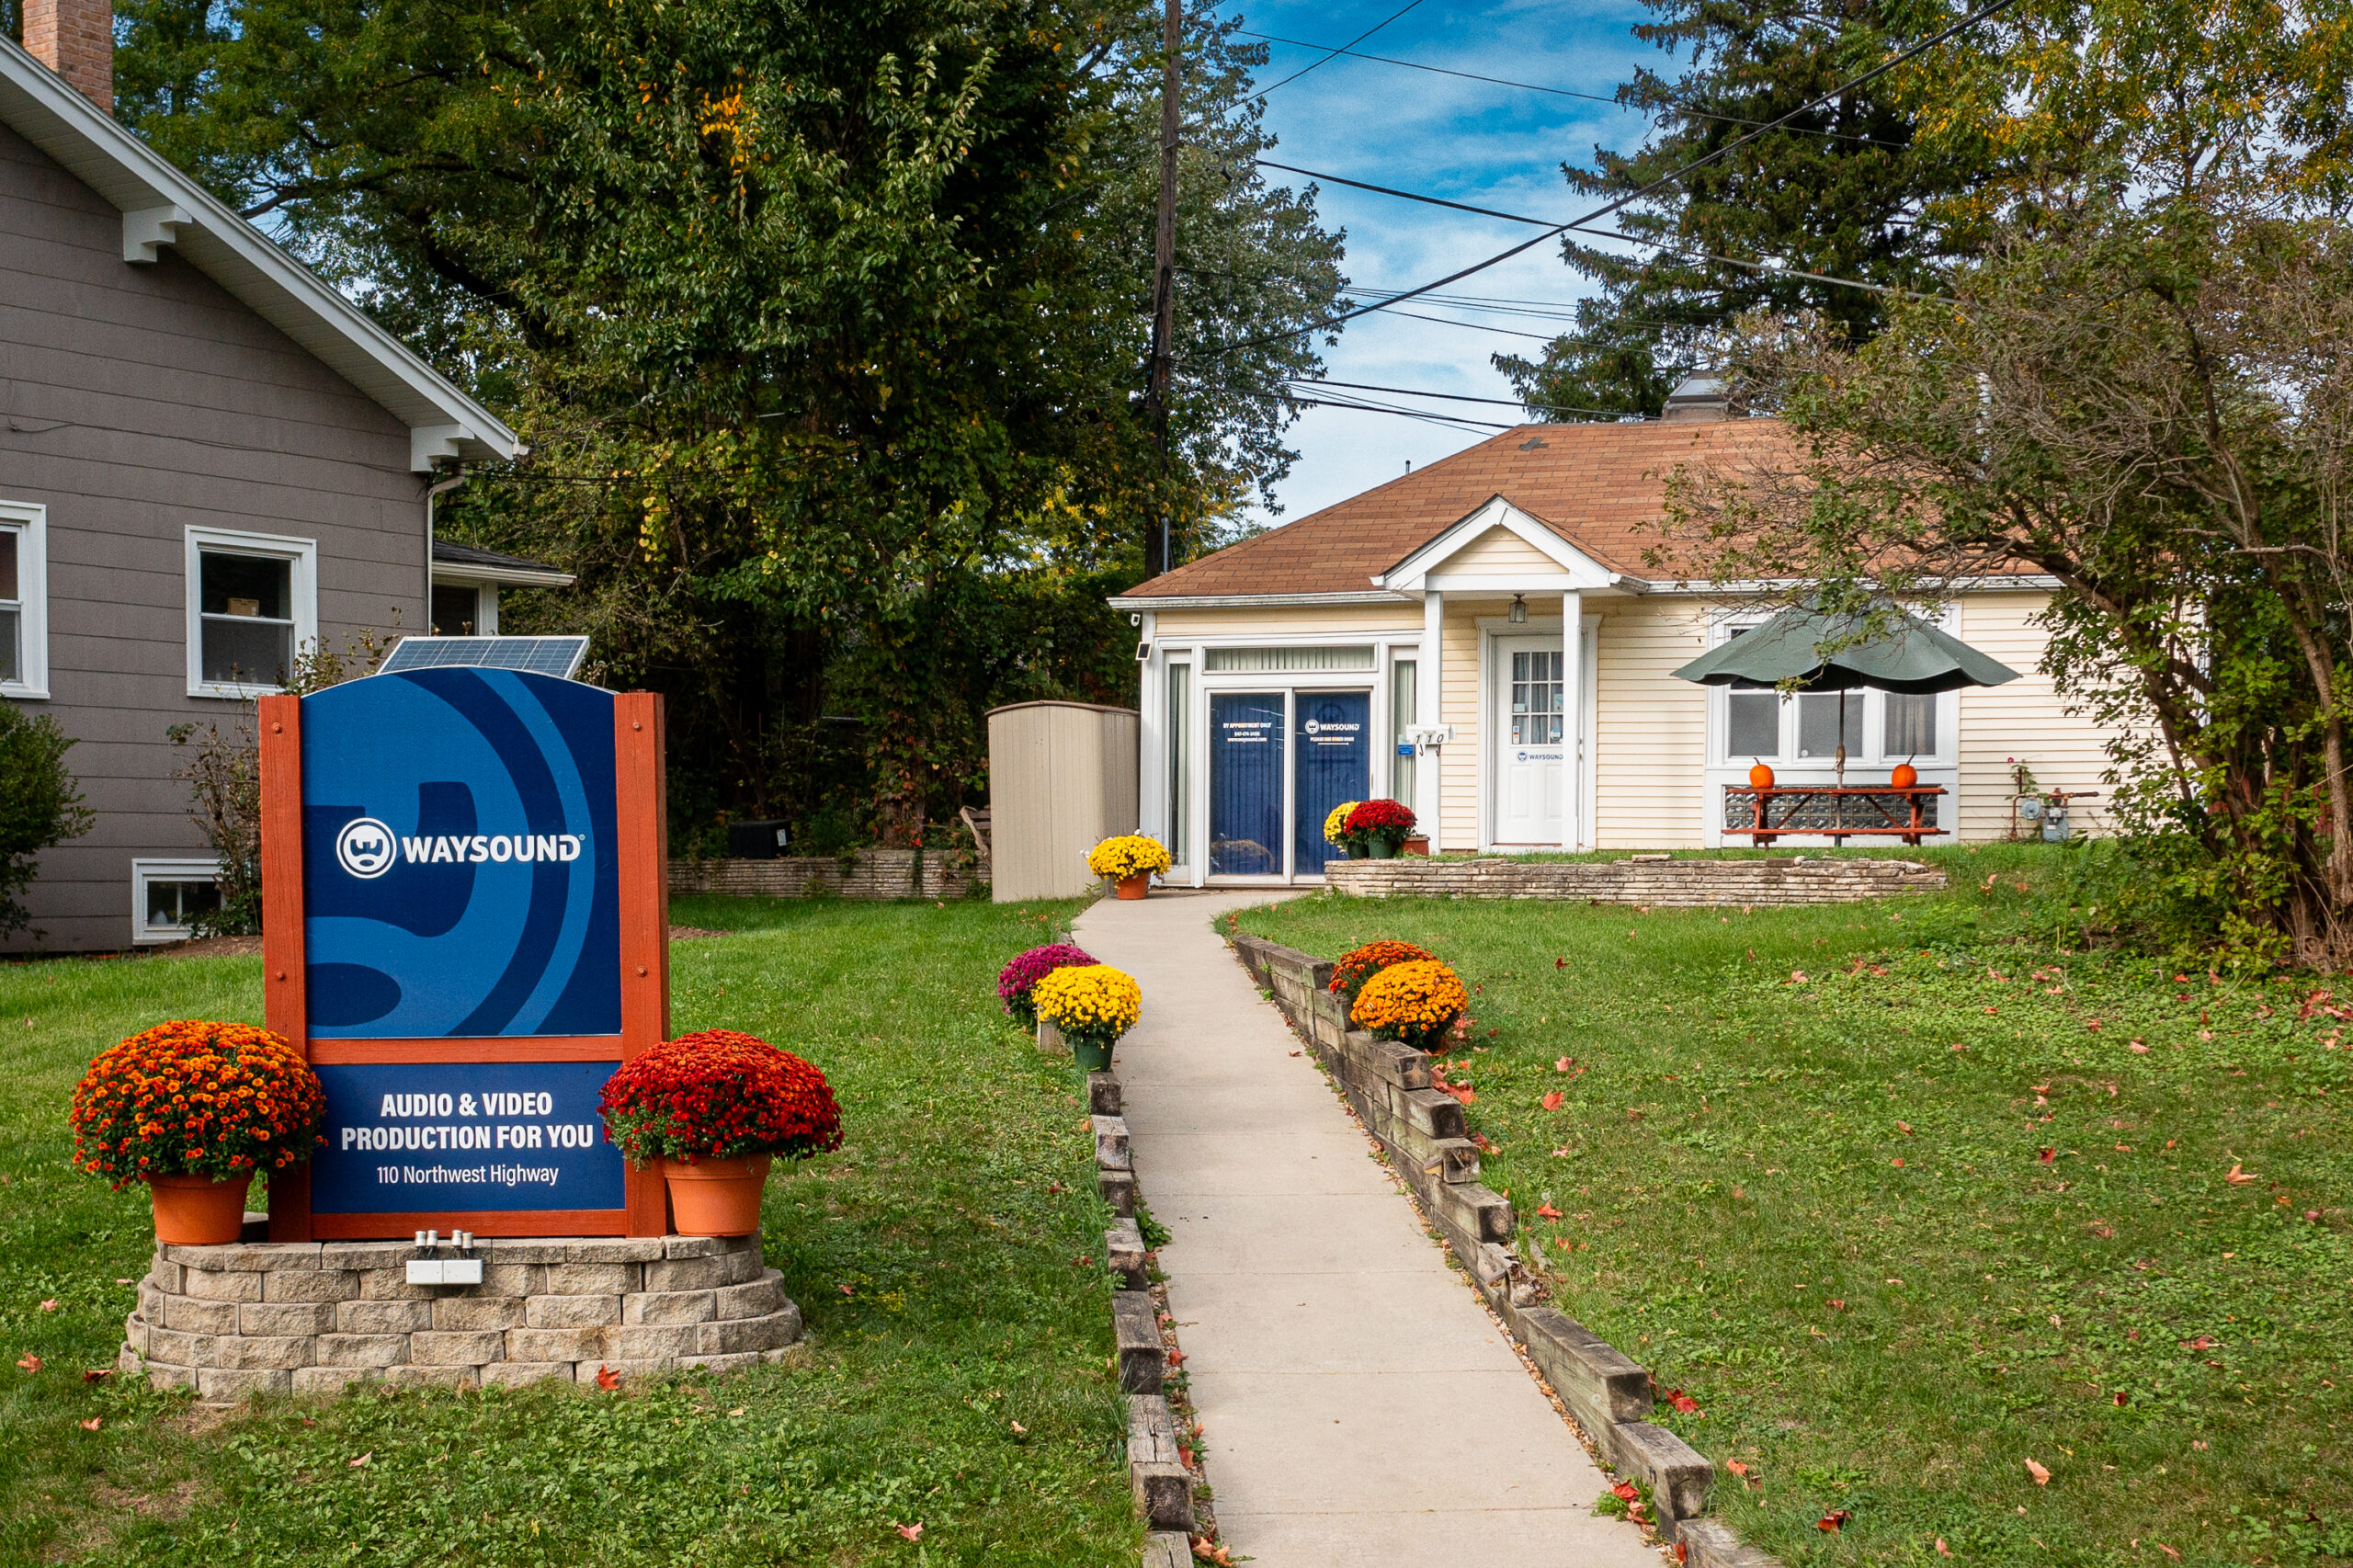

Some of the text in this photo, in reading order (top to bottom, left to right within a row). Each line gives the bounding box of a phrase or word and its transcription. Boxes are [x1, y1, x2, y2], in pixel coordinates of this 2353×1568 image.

[1416, 734, 1444, 744] 110
[381, 1092, 552, 1117] AUDIO & VIDEO
[342, 1124, 594, 1150] PRODUCTION FOR YOU
[377, 1164, 559, 1186] 110 Northwest Highway
